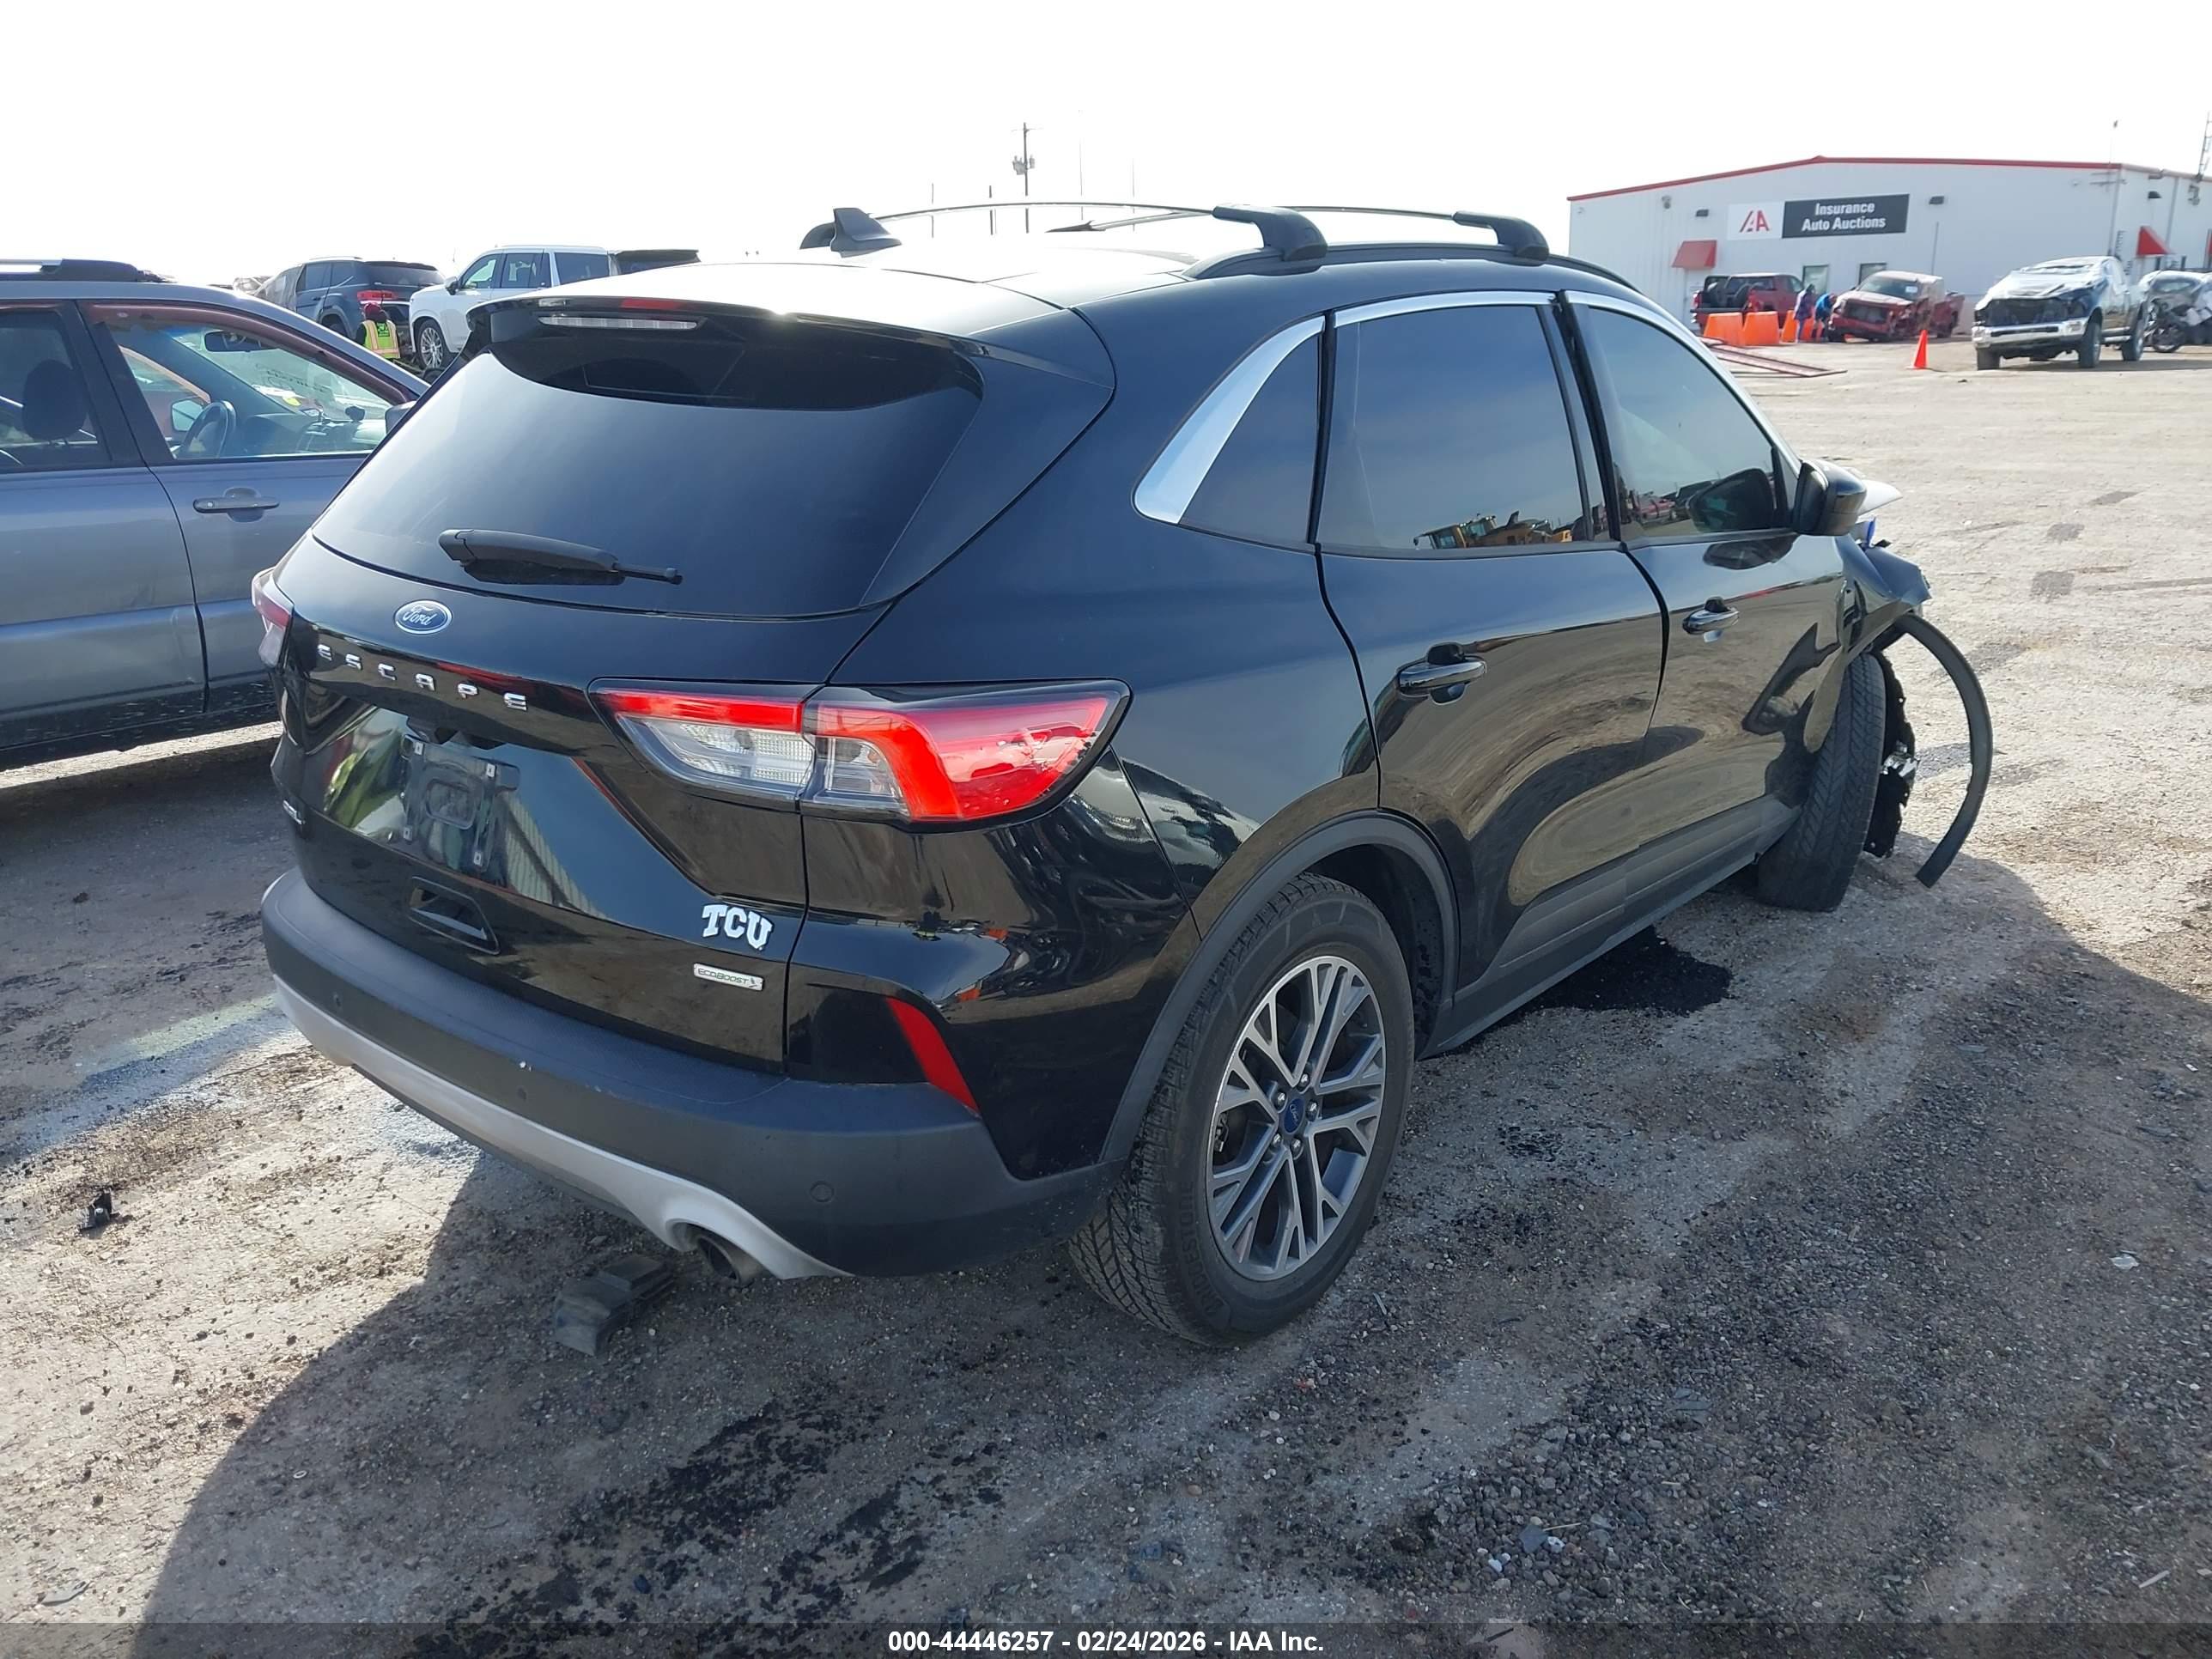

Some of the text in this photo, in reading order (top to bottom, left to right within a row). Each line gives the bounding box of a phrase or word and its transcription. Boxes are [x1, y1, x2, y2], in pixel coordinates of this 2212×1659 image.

[1814, 202, 1875, 216] Insurance
[1801, 216, 1887, 232] Auto Auctions
[403, 605, 437, 626] Ford
[317, 644, 527, 711] ESCAPE
[702, 904, 773, 950] TCU
